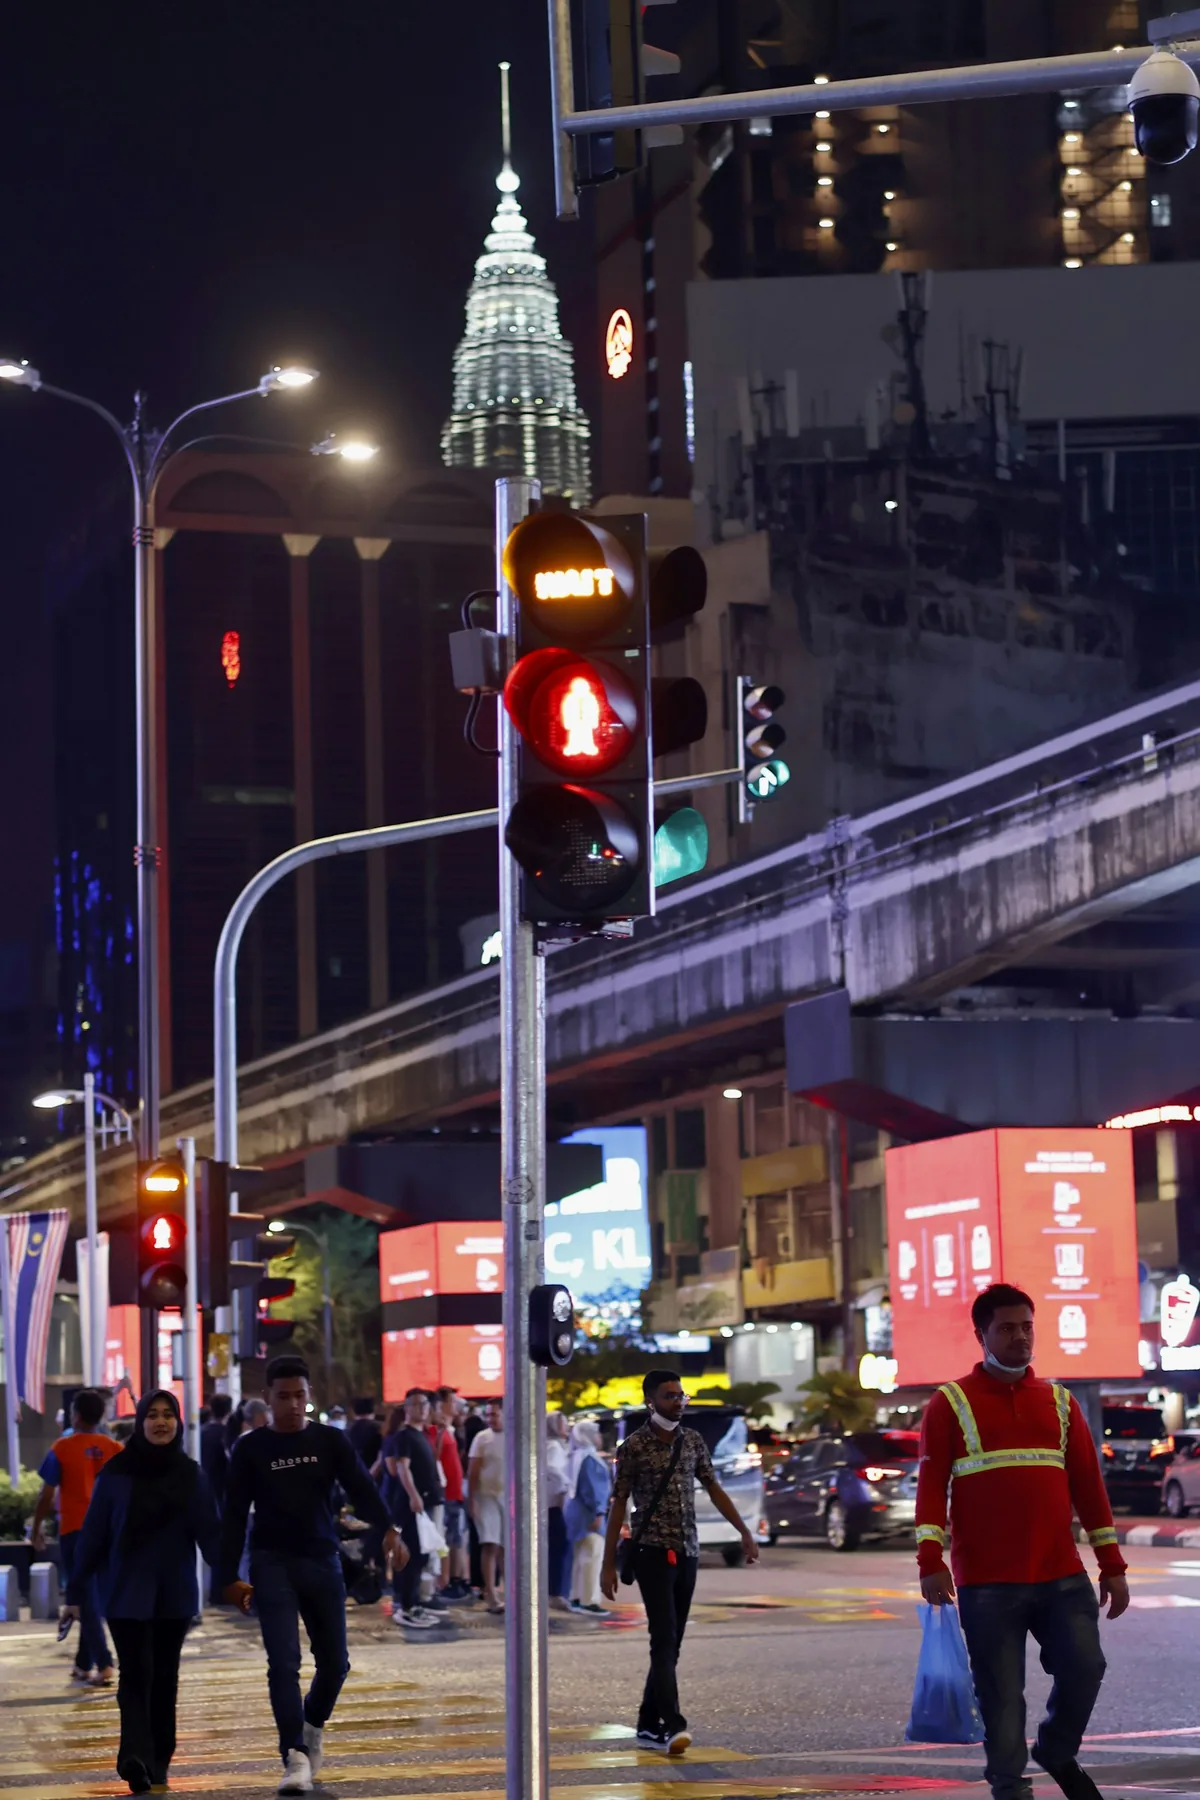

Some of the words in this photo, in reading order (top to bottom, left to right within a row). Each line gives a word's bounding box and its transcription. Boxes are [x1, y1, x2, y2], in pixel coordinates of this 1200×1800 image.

[535, 568, 614, 600] WAIT
[592, 1227, 651, 1271] KL
[270, 1455, 319, 1469] chosen
